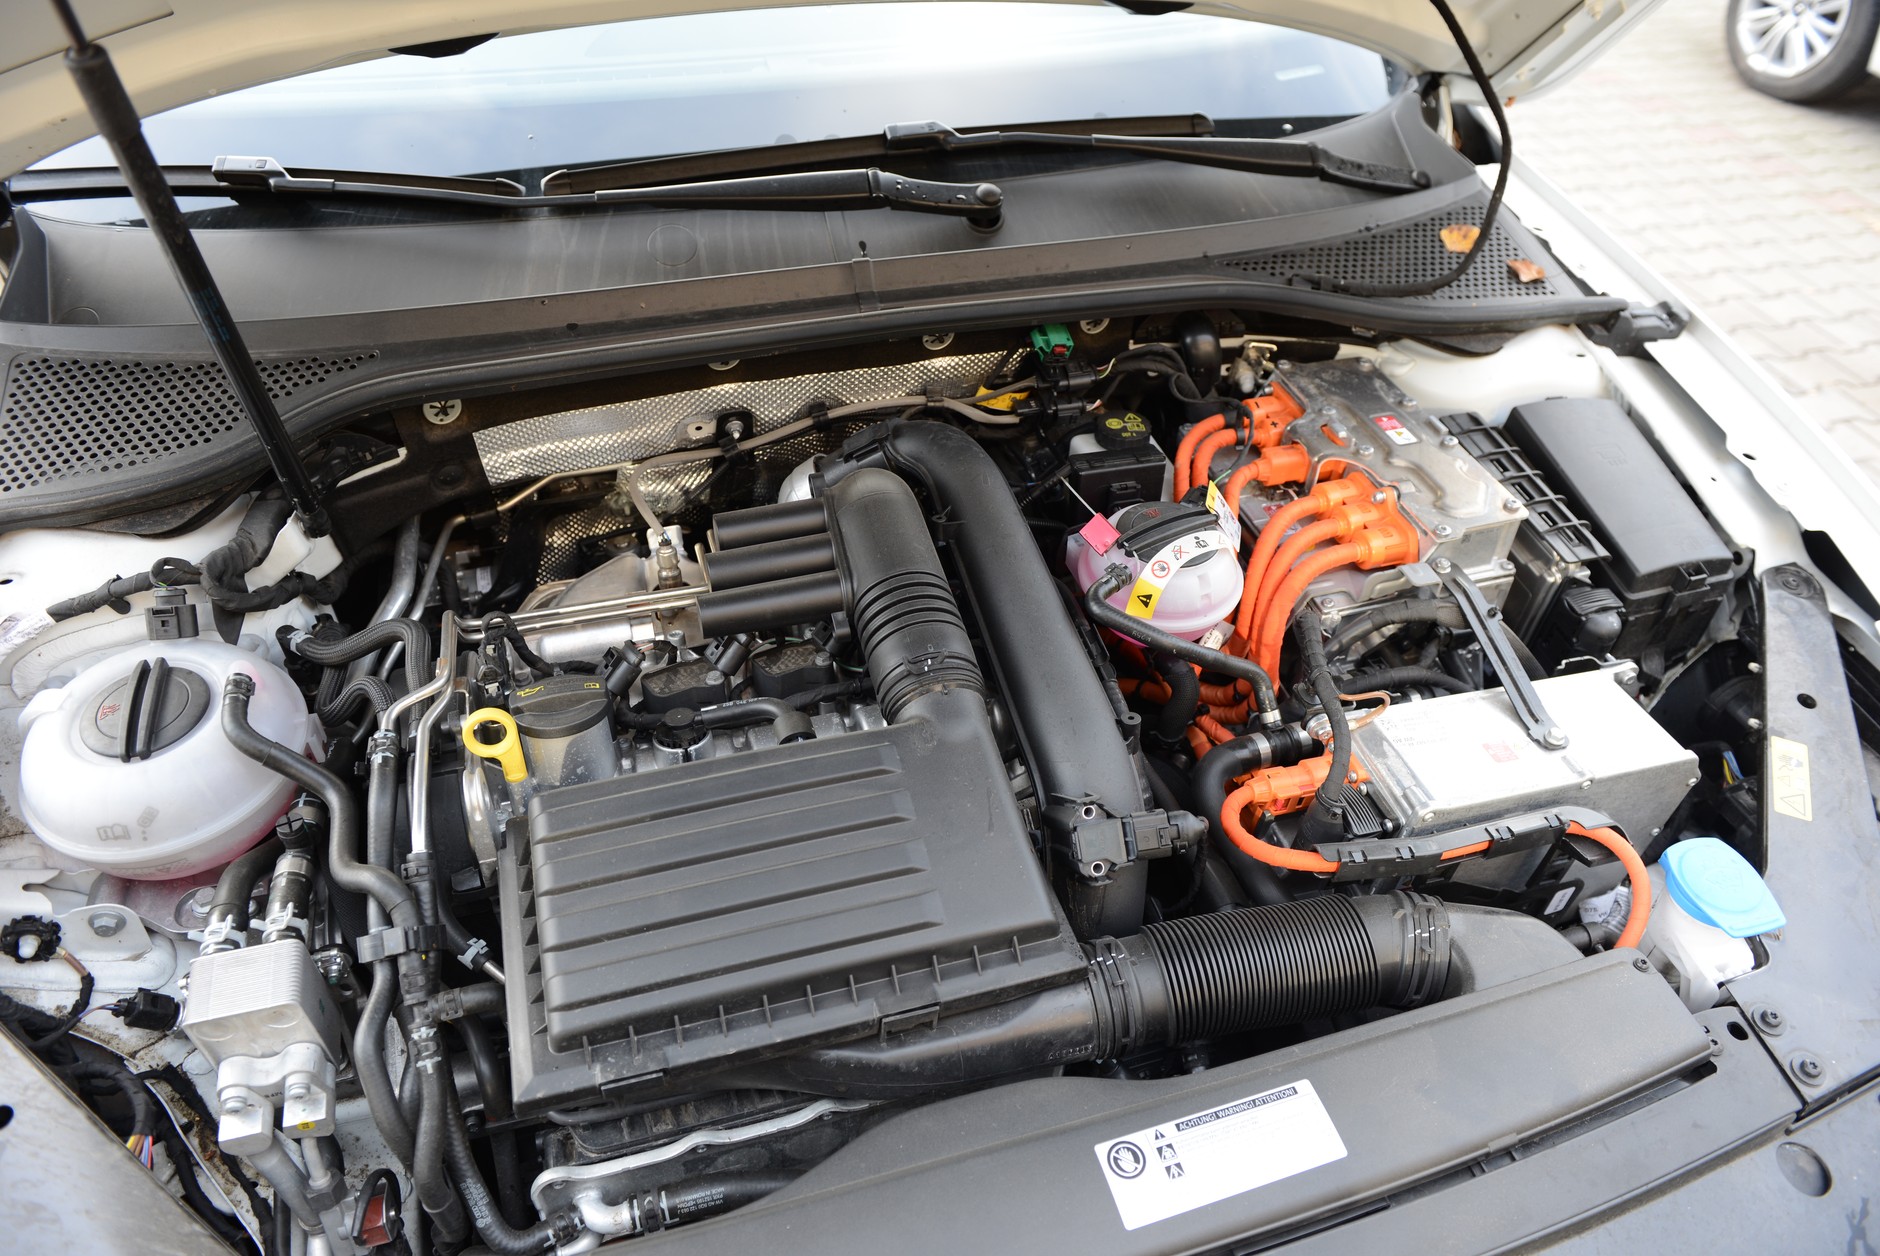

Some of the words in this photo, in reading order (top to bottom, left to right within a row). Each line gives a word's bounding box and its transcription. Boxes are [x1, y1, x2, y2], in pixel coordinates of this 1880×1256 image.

[1179, 1112, 1217, 1131] ACHTUNG!
[1217, 1101, 1256, 1119] WARNING!
[1255, 1087, 1296, 1107] ATTENTION!
